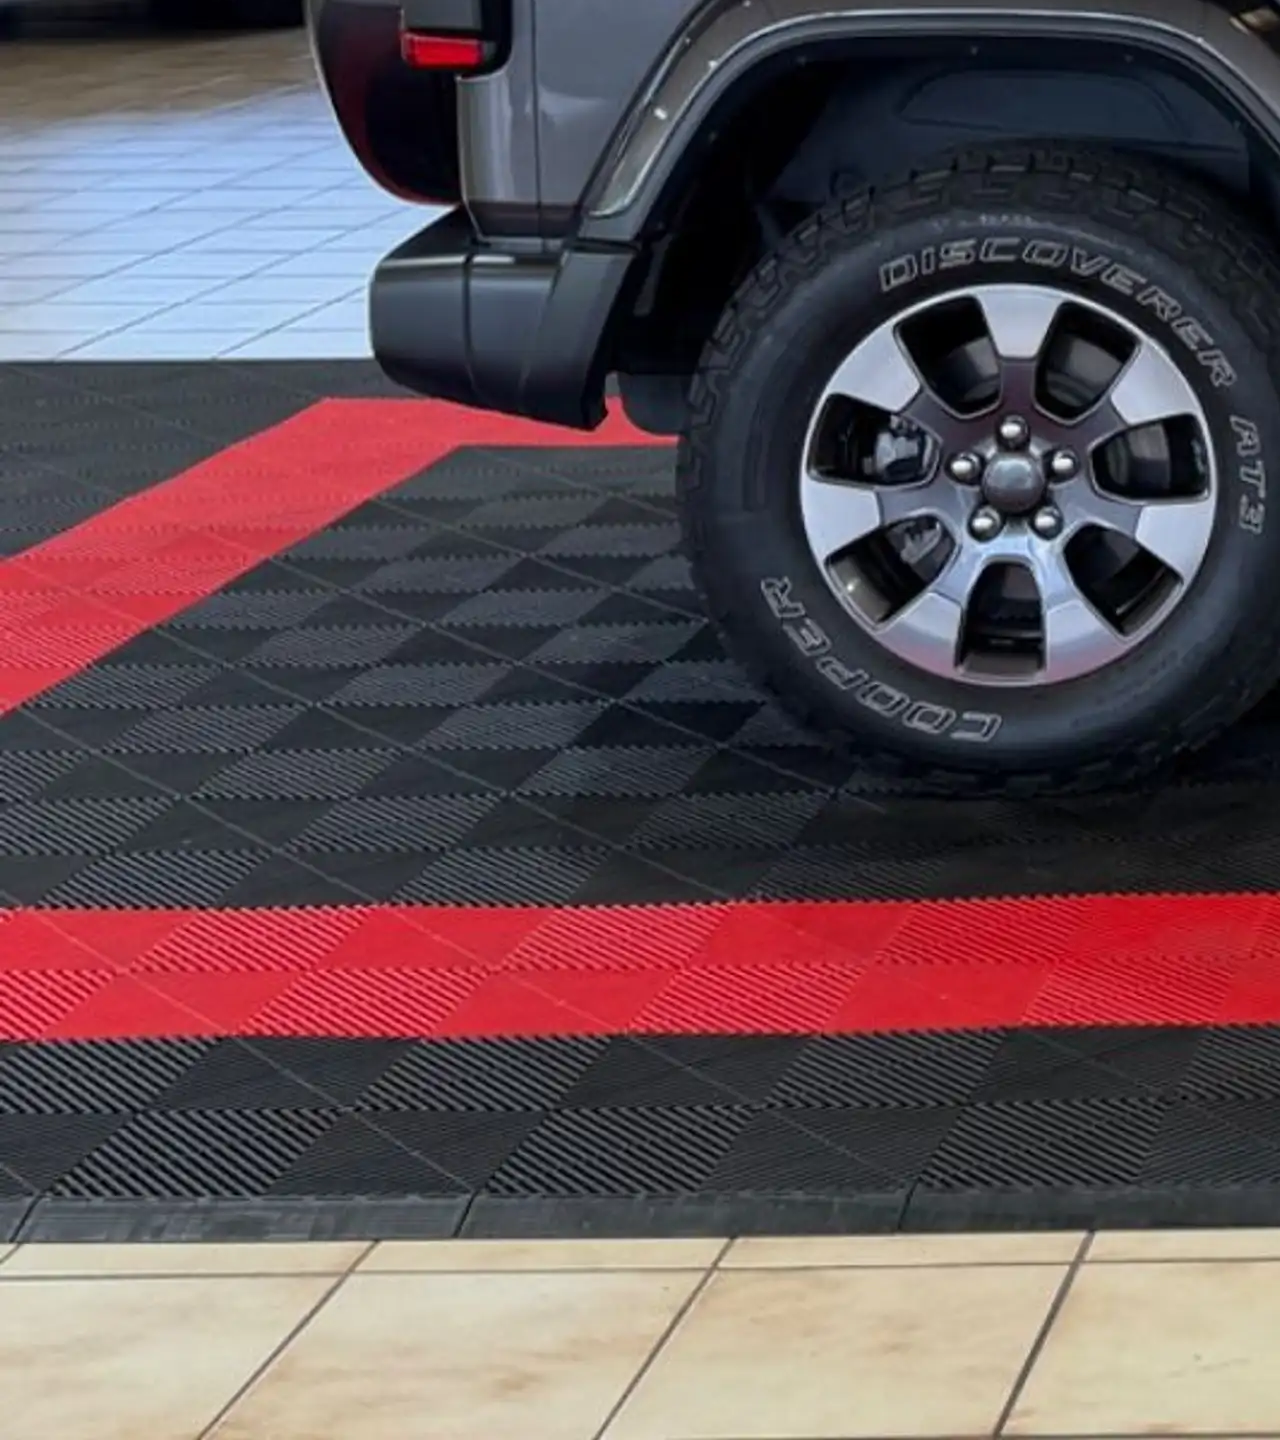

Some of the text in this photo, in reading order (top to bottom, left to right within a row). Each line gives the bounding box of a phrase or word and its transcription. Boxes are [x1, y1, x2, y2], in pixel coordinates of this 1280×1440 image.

[879, 237, 1266, 534] DISCOVERER AT3
[761, 577, 1001, 742] COOPER
